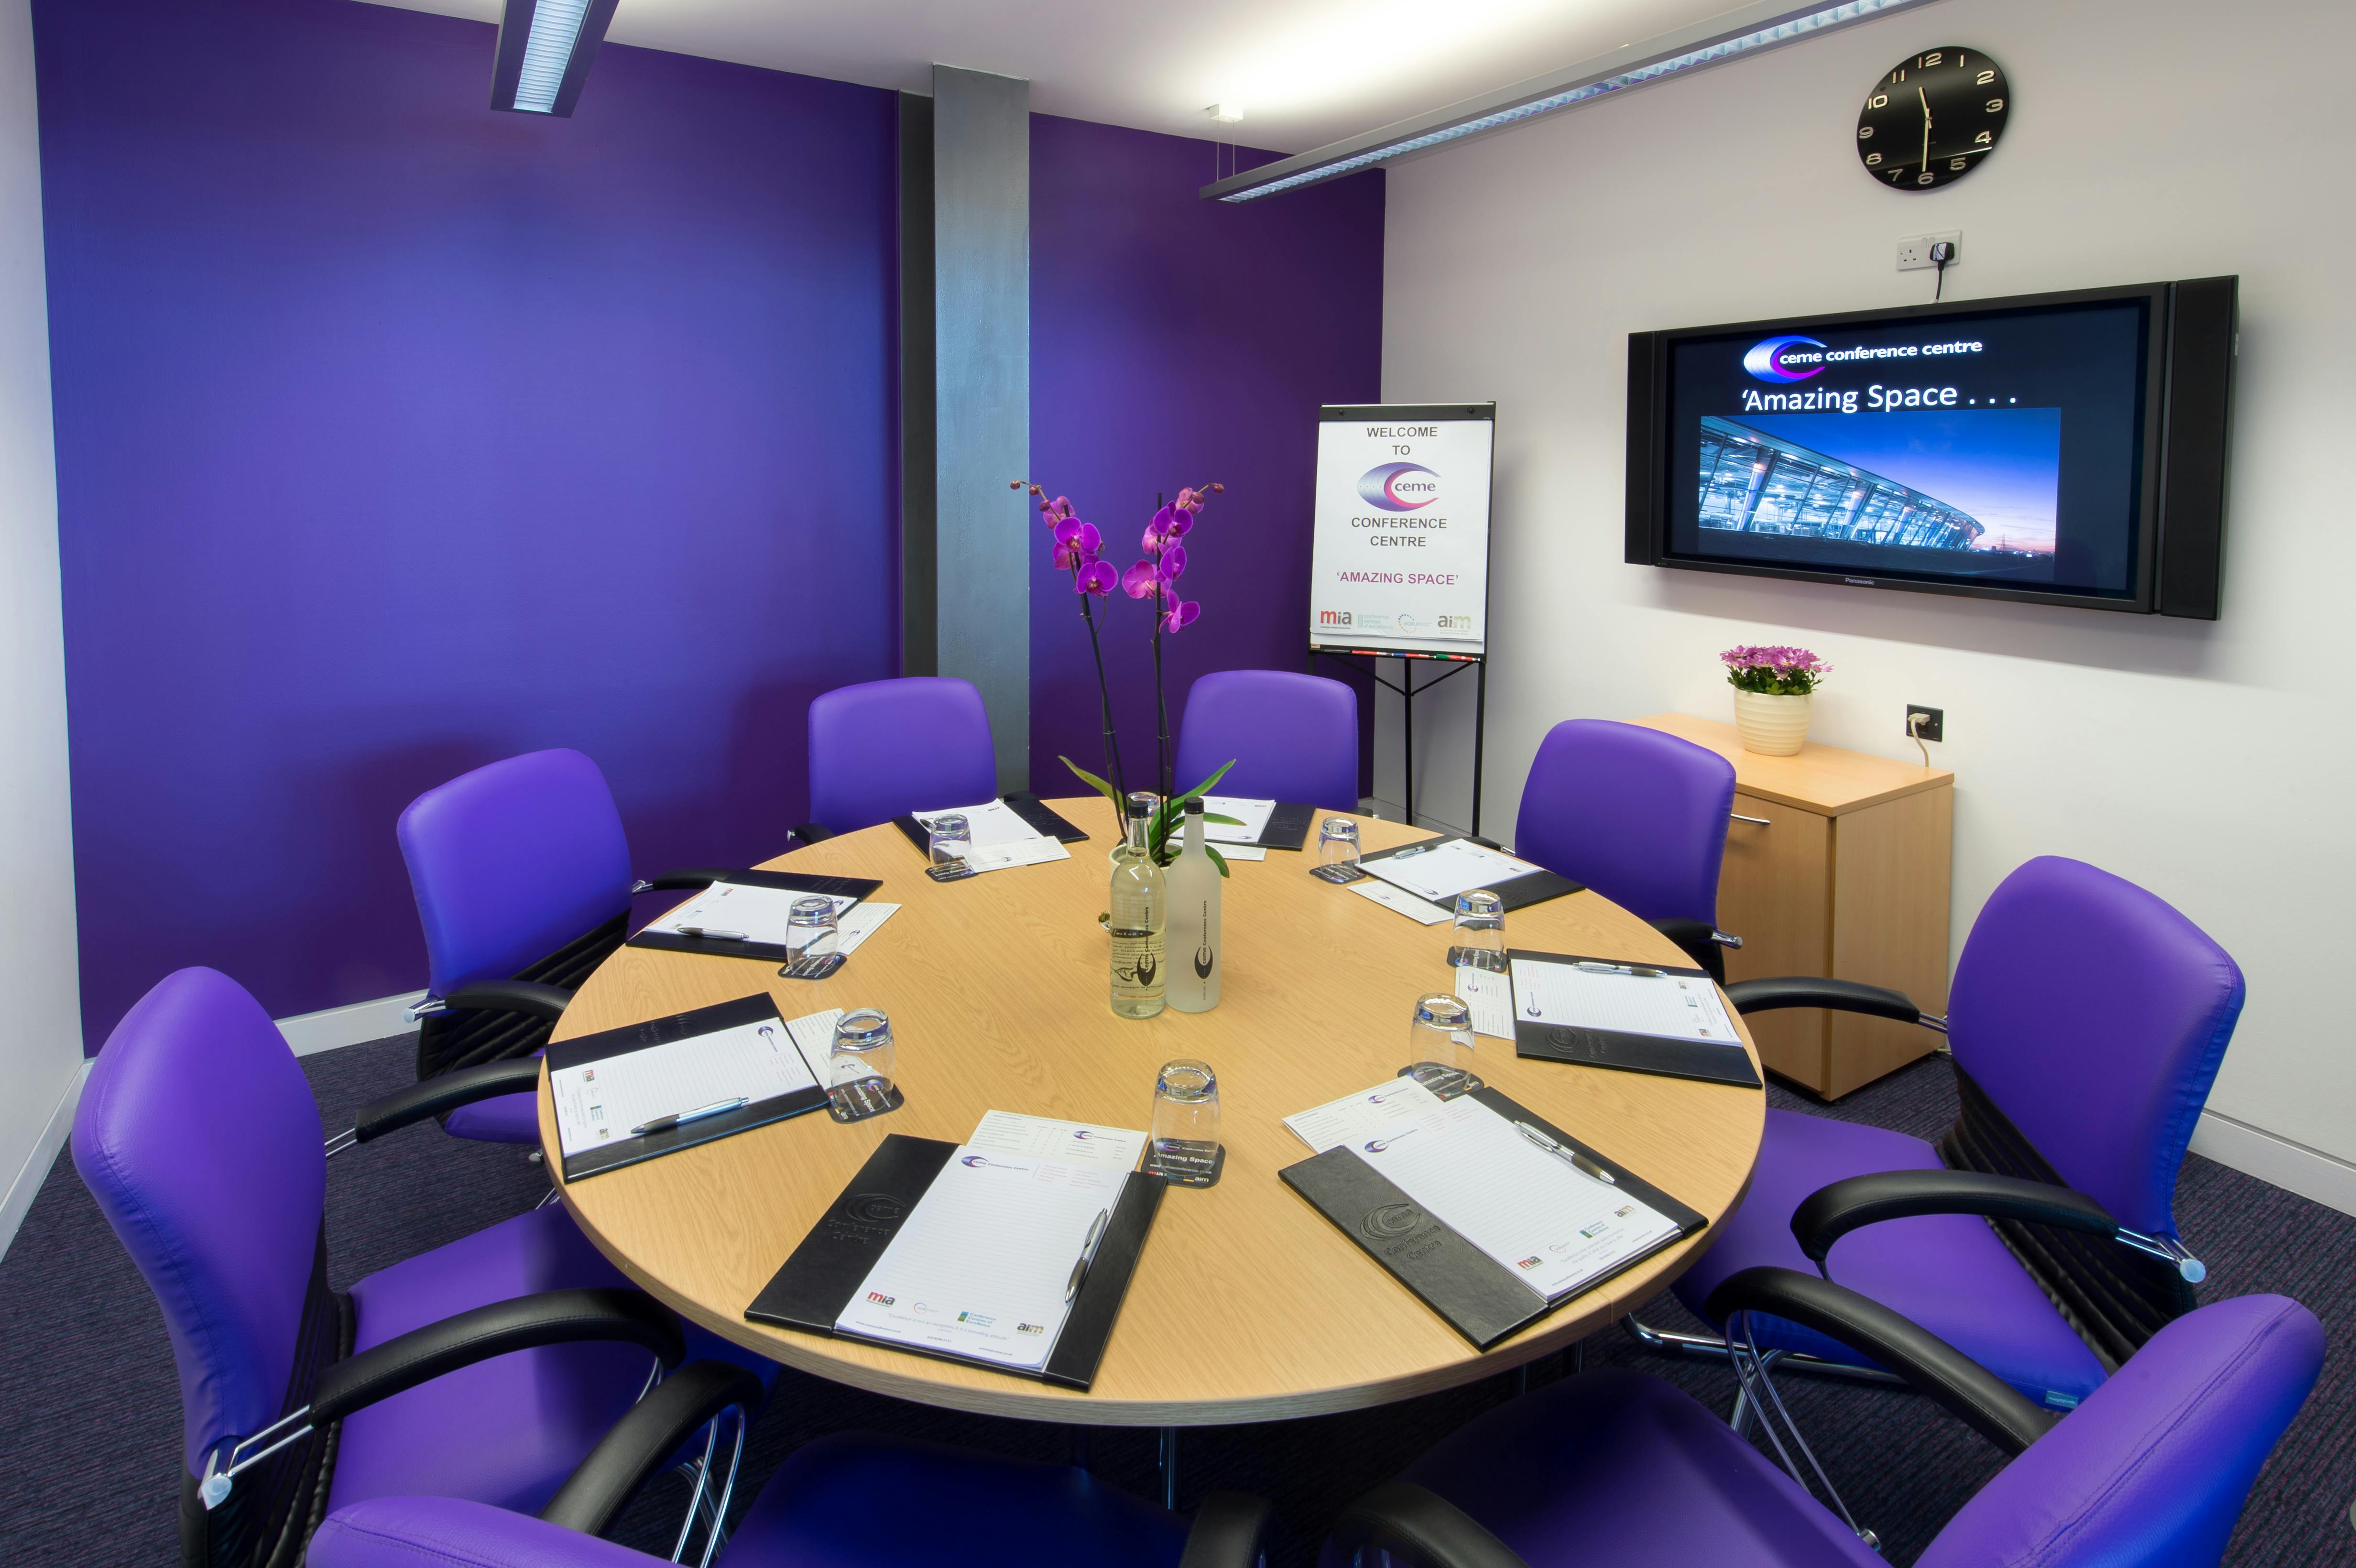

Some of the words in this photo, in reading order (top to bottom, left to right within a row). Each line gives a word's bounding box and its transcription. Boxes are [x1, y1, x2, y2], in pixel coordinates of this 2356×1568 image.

[1918, 52, 1942, 69] 12
[1960, 54, 1964, 67] 1
[1892, 69, 1905, 84] 11
[1976, 70, 1996, 85] 2
[1867, 95, 1888, 109] 10
[1985, 99, 2003, 112] 3
[1859, 127, 1874, 139] 9
[1974, 131, 1992, 144] 4
[1865, 153, 1882, 165] 8
[1950, 157, 1966, 171] 5
[1887, 169, 1903, 181] 7
[1918, 172, 1934, 185] 6
[1779, 351, 1822, 365] ceme
[1825, 345, 1918, 362] conference
[1922, 341, 1983, 356] centre
[1742, 386, 1859, 414] ‘Amazing
[1867, 384, 1957, 413] Space
[1366, 426, 1438, 438] WELCOME
[1393, 445, 1410, 456] TO
[1395, 481, 1436, 492] ceme
[1351, 517, 1447, 529] CONFERENCE
[1370, 536, 1427, 547] CENTRE
[1337, 571, 1404, 584] ‘AMAZING
[1408, 573, 1459, 586] SPACE’
[1320, 610, 1352, 625] mia
[1438, 615, 1472, 629] aim
[1614, 1205, 1635, 1218] aim
[1385, 1225, 1441, 1256] Conference
[1407, 1240, 1442, 1260] Centre
[1517, 1256, 1543, 1269] mia
[867, 1292, 895, 1306] mia
[970, 1312, 997, 1321] Conference
[966, 1319, 991, 1328] Excellence
[1017, 1323, 1044, 1334] aim
